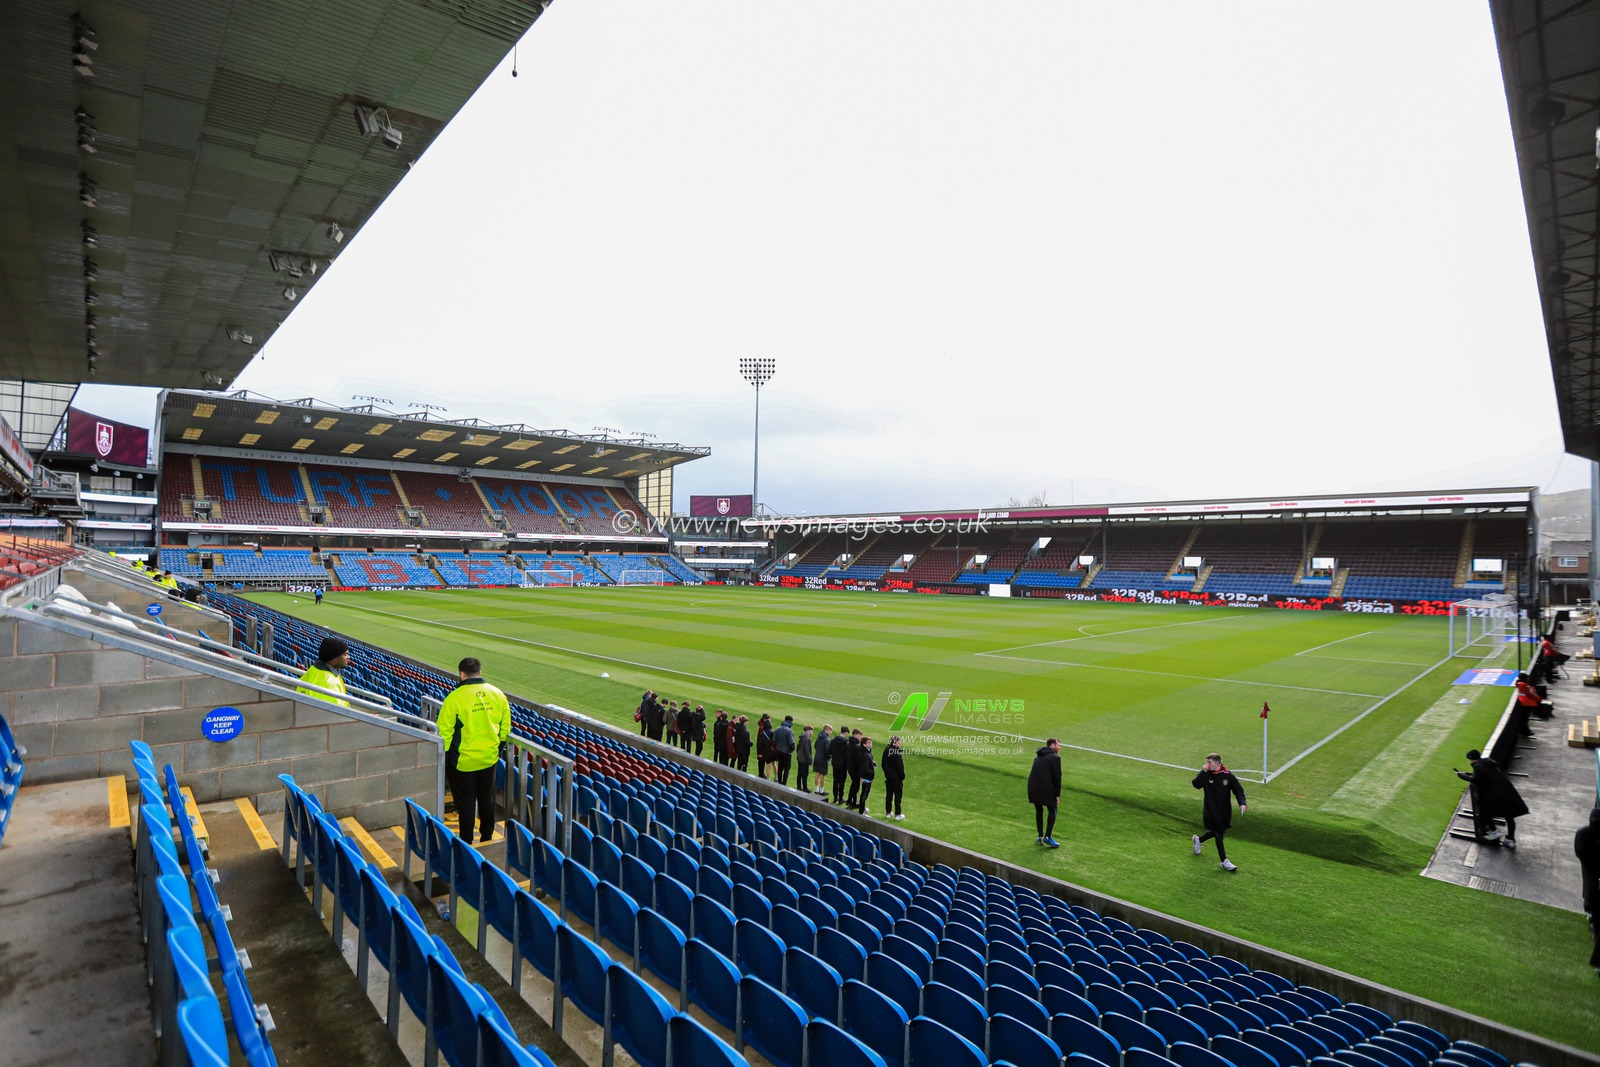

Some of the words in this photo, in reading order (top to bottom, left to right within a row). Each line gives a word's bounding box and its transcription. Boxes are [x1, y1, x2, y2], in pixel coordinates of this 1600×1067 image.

[202, 463, 393, 508] TURF
[479, 482, 629, 518] MOOR
[758, 574, 779, 583] 32Red
[781, 575, 803, 584] 32Red
[804, 576, 828, 585] 32Red
[1065, 593, 1098, 601] 32Red
[1111, 588, 1155, 598] 32Red
[1216, 592, 1269, 602] 32Red
[1342, 603, 1395, 614] 32Red
[206, 715, 241, 723] GANGWAY
